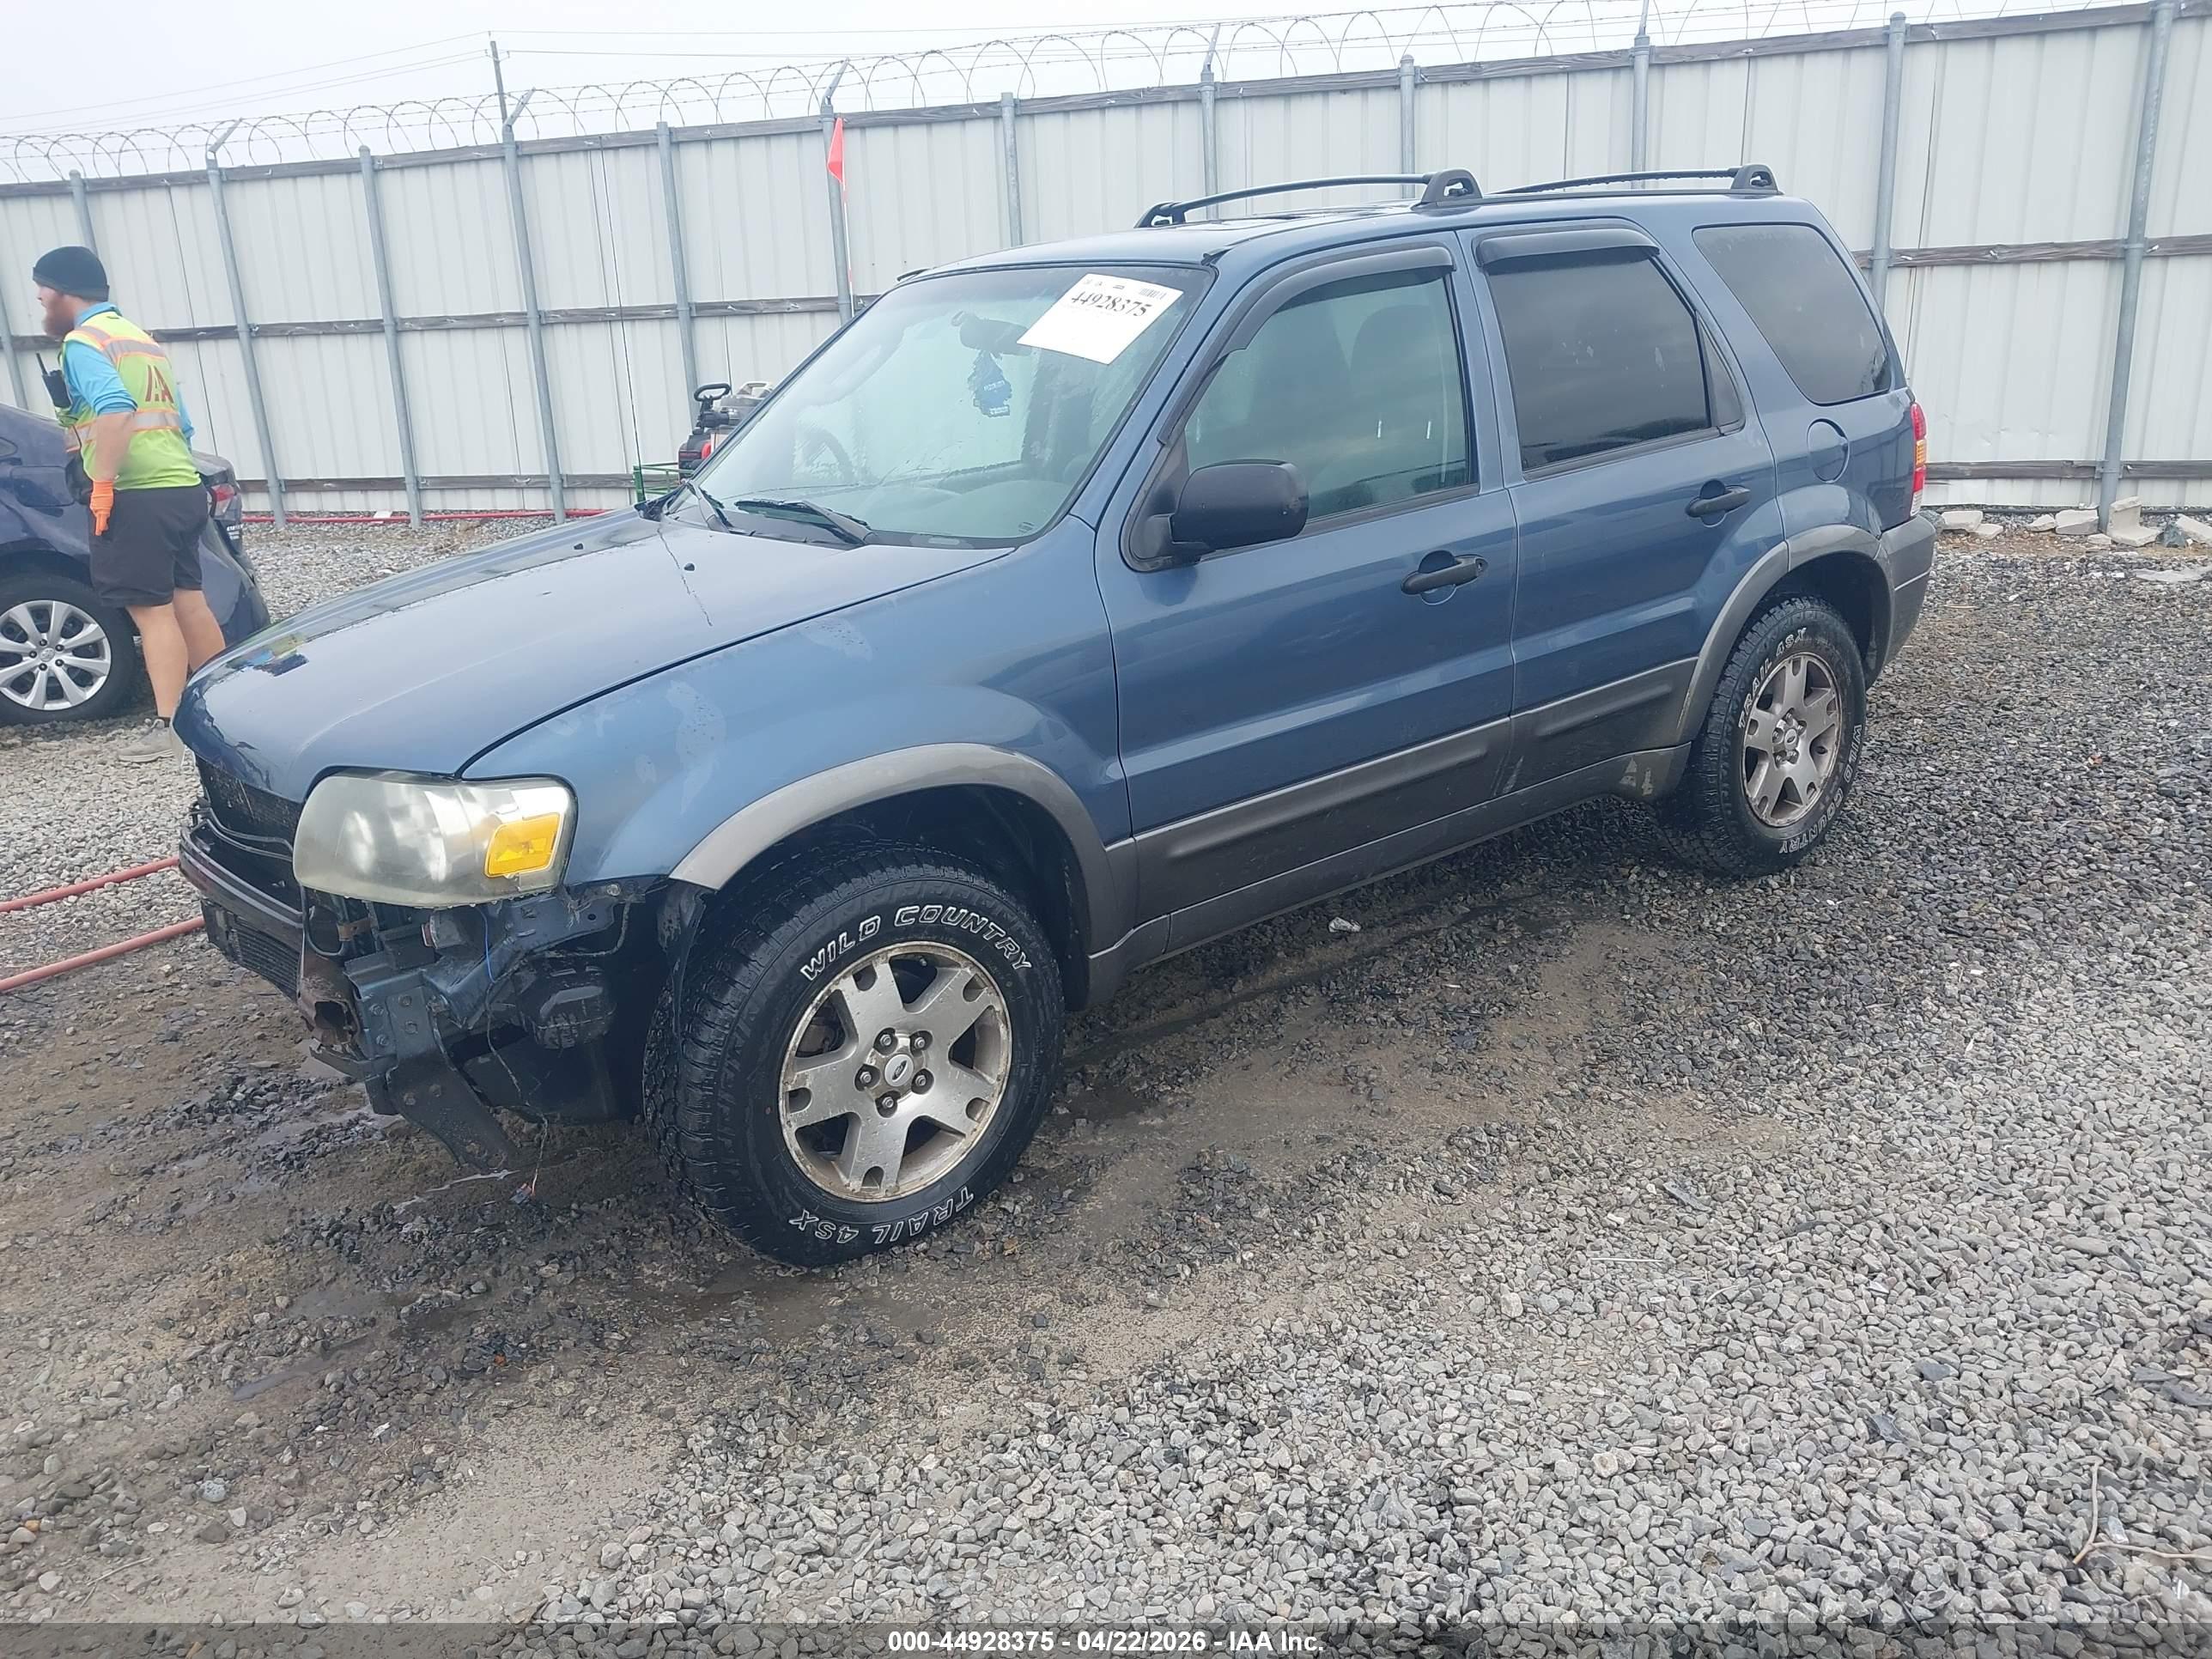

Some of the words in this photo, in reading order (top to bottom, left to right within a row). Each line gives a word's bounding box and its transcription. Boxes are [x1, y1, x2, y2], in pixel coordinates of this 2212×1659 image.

[1071, 290, 1152, 317] 44928375
[1738, 657, 1772, 728] TRAIL
[1843, 724, 1863, 783] WILD
[1778, 787, 1844, 854] COUNTRY
[799, 915, 881, 981] WILD
[893, 903, 1033, 970] COUNTRY
[788, 1208, 860, 1244] 4SX
[872, 1186, 975, 1244] TRAIL
